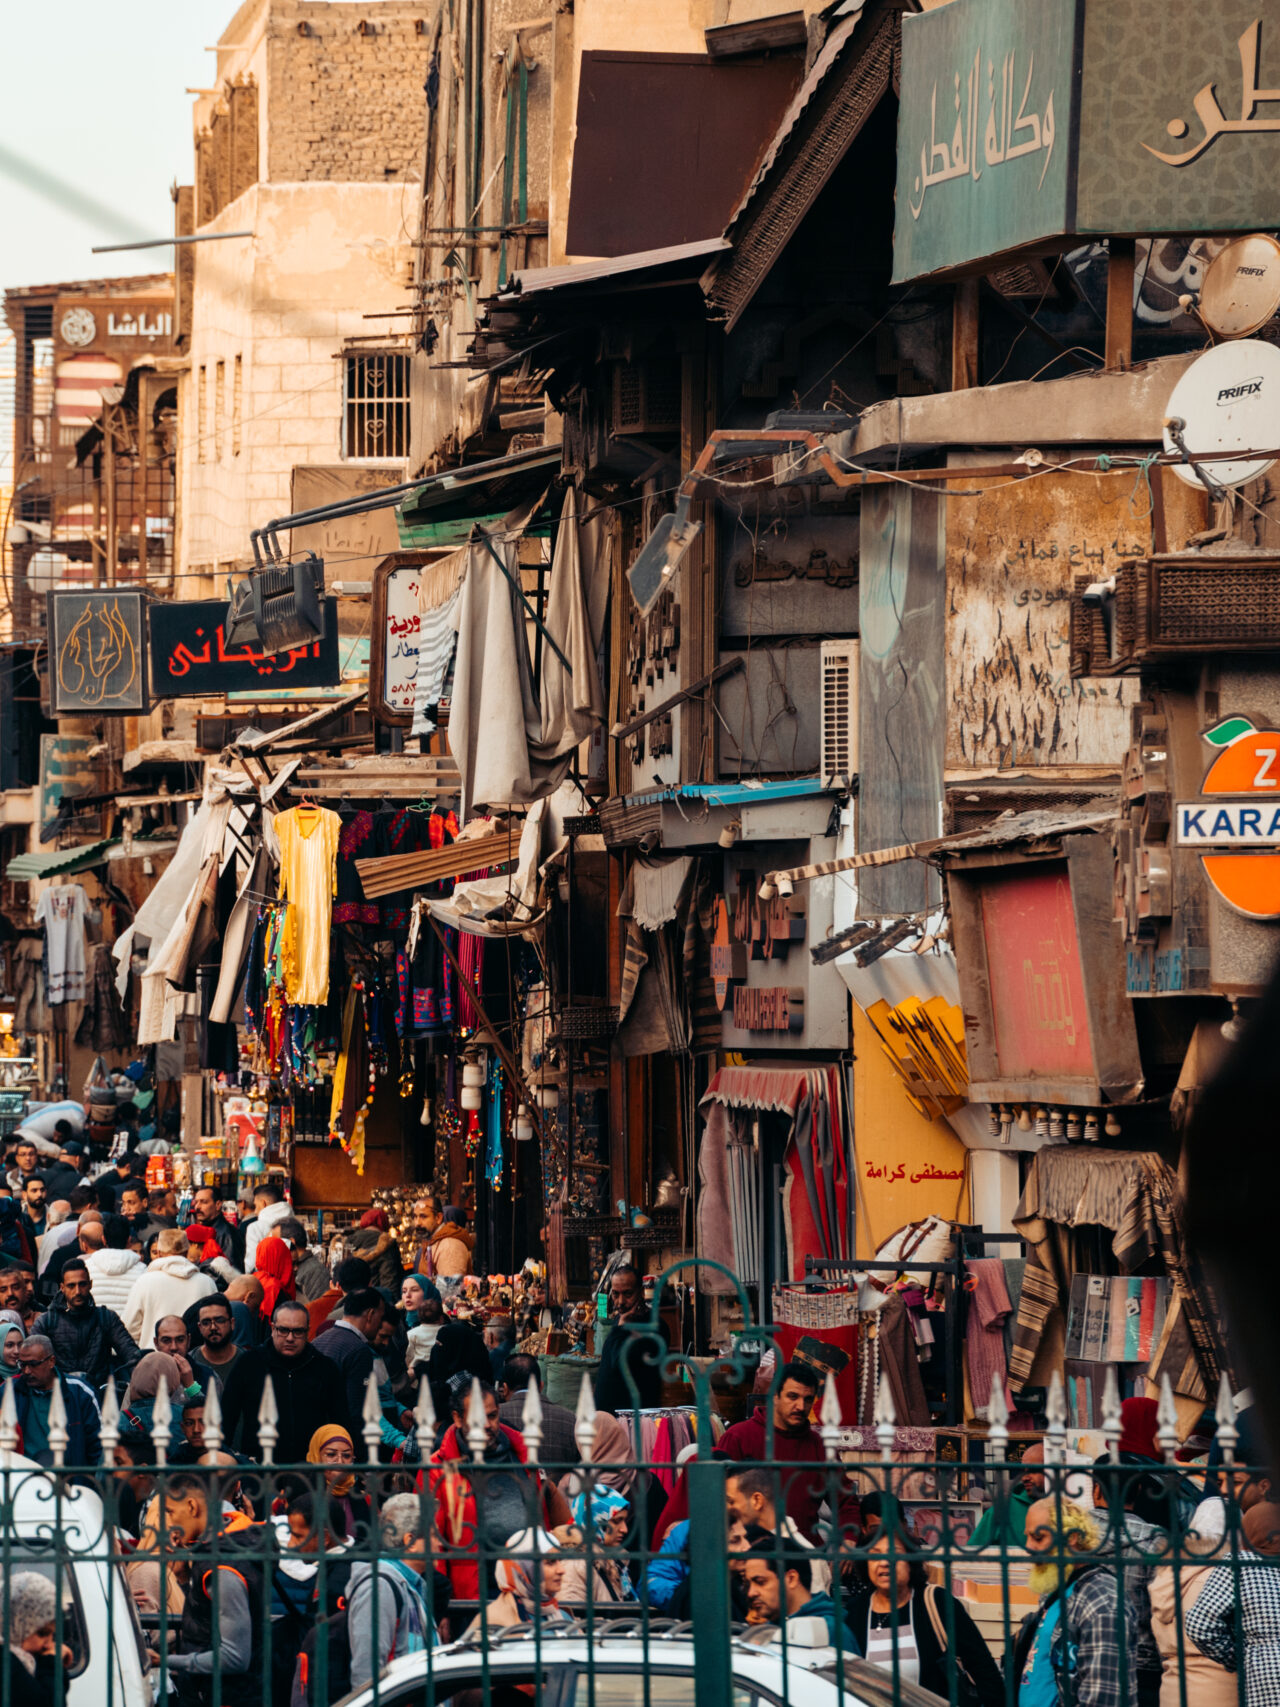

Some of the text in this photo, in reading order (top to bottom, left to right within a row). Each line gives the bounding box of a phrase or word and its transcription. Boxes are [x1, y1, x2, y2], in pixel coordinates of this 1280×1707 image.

[909, 45, 1056, 221] وكالة القطن
[1235, 265, 1266, 278] PRIFIX
[107, 312, 172, 342] الباشا
[1217, 381, 1263, 401] PRIFIX
[865, 1161, 965, 1184] مصطفى كرامة
